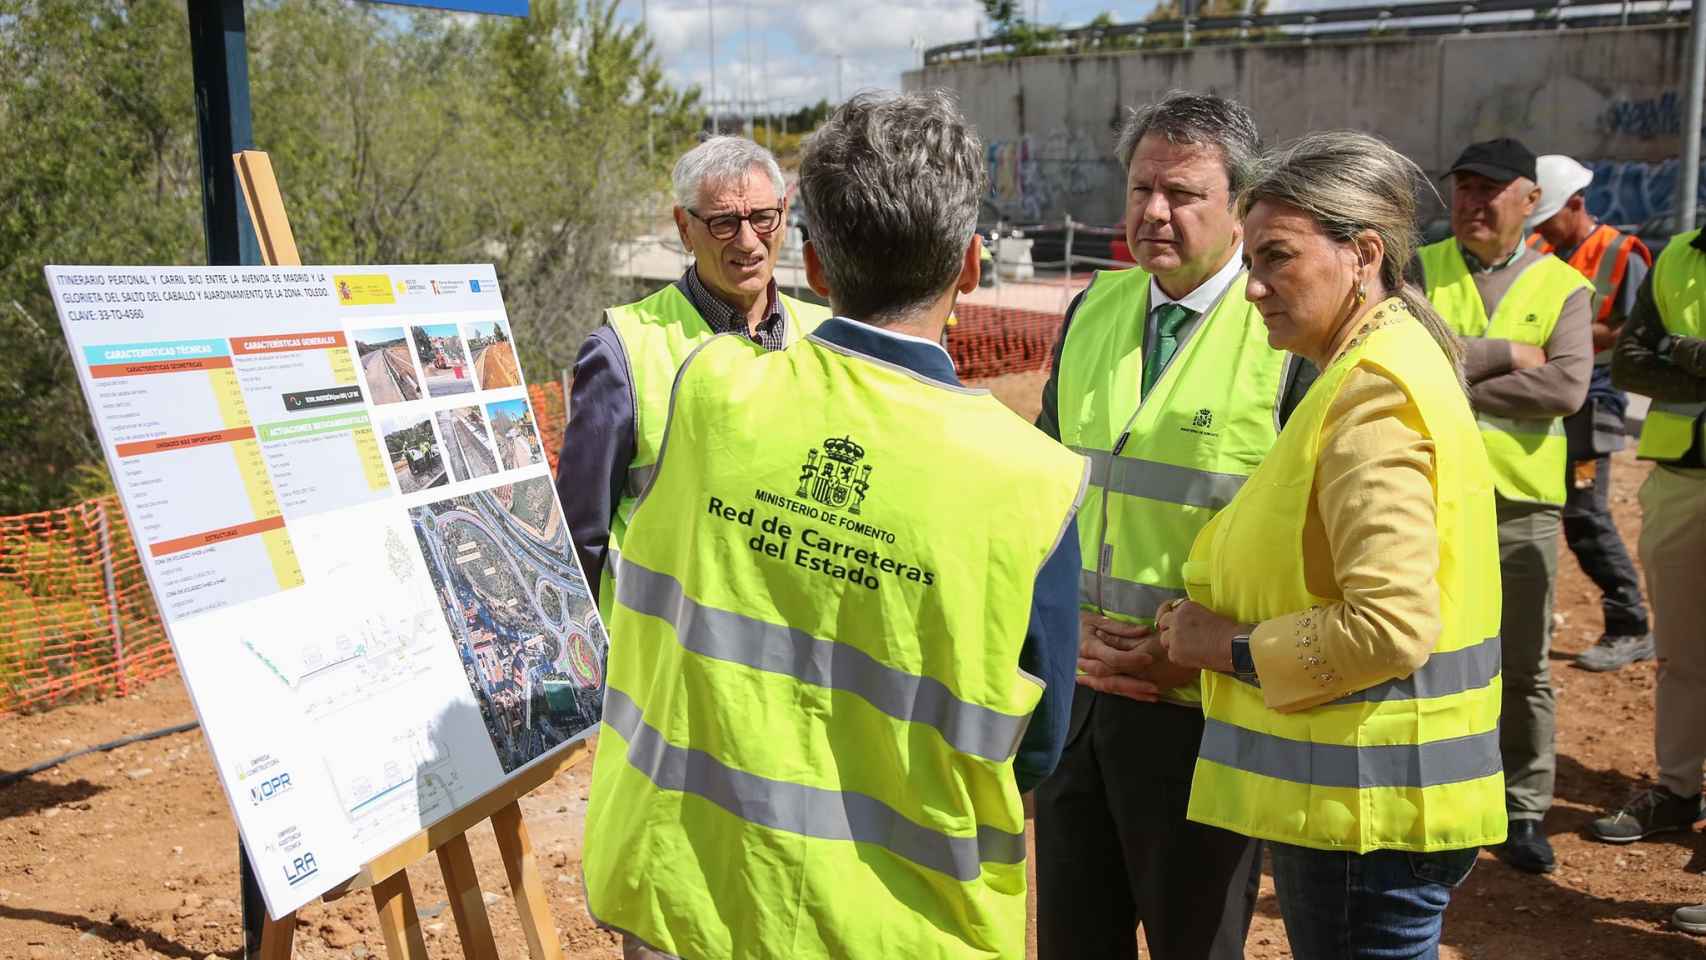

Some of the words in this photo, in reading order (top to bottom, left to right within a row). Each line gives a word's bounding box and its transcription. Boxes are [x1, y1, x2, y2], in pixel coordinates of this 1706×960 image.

[56, 275, 105, 286] ITINERARIO
[108, 274, 150, 285] PEATONAL
[151, 275, 157, 285] Y
[160, 274, 186, 284] CARRIL
[188, 273, 203, 284] BICI
[205, 273, 227, 284] ENTRE
[230, 273, 239, 283] LA
[242, 273, 270, 283] AVENIDA
[272, 273, 281, 282] DE
[283, 272, 309, 282] MADRID
[317, 273, 326, 281] LA
[62, 292, 103, 303] GLORIETA
[104, 291, 120, 303] DEL
[121, 291, 145, 302] SALTO
[147, 291, 161, 302] DEL
[163, 291, 195, 302] CABALLO
[203, 288, 263, 300] AJARDINAMIENTO
[264, 288, 273, 298] DE
[274, 288, 283, 298] LA
[68, 310, 97, 321] CLAVE:
[755, 489, 819, 519] MINISTERIO
[821, 511, 836, 526] DE
[839, 516, 896, 544] FOMENTO
[708, 496, 754, 527] Red
[762, 516, 792, 540] de
[801, 528, 935, 586] Carreteras
[749, 534, 787, 561] del
[795, 548, 880, 590] Estado
[283, 852, 318, 881] LRA
